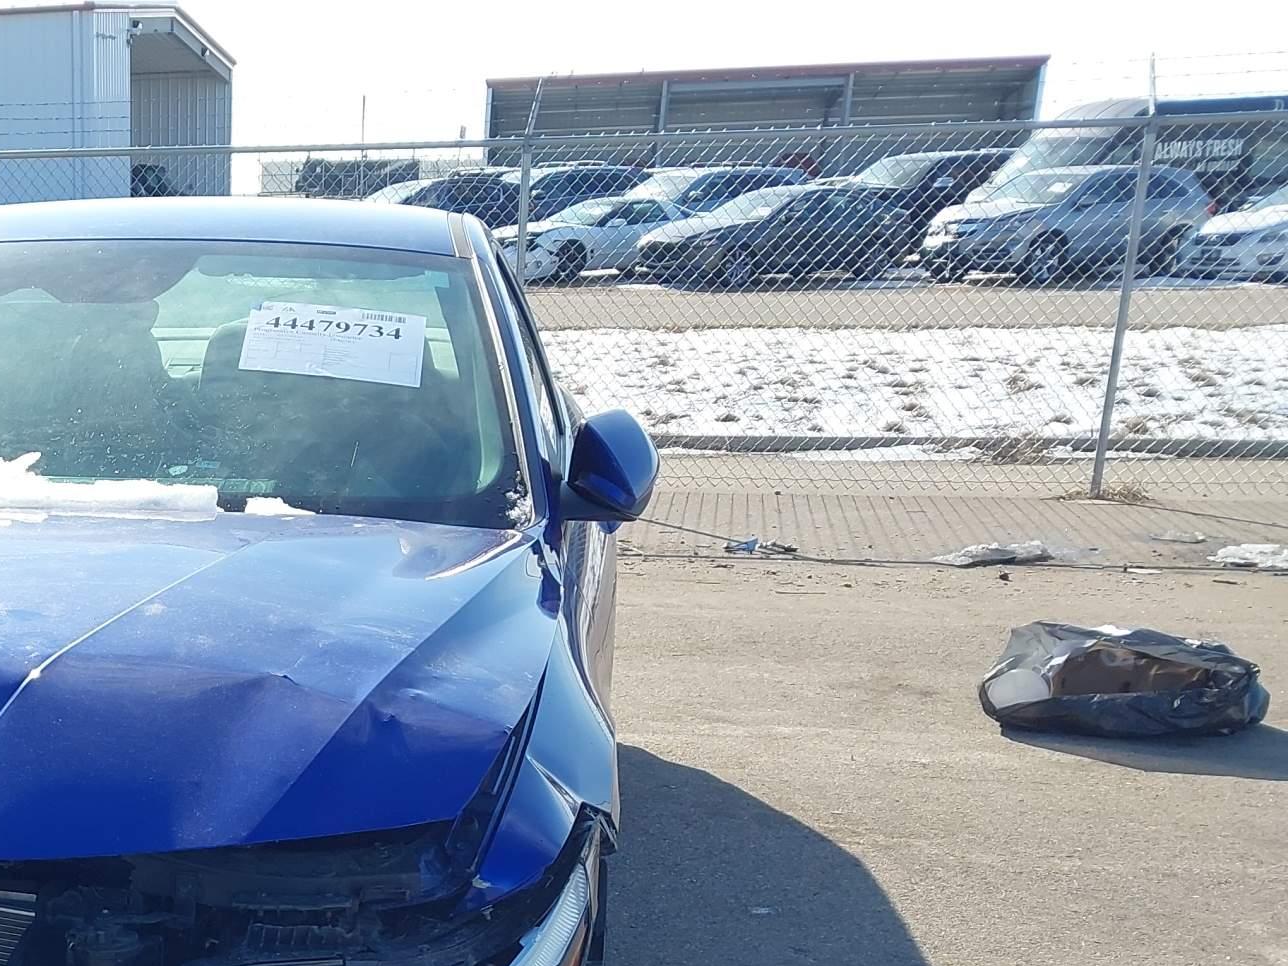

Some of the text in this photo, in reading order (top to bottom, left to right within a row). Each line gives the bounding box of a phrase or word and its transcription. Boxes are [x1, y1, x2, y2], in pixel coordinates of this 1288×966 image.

[1155, 138, 1244, 160] ALWAYS FRESH
[265, 315, 403, 340] 44479734
